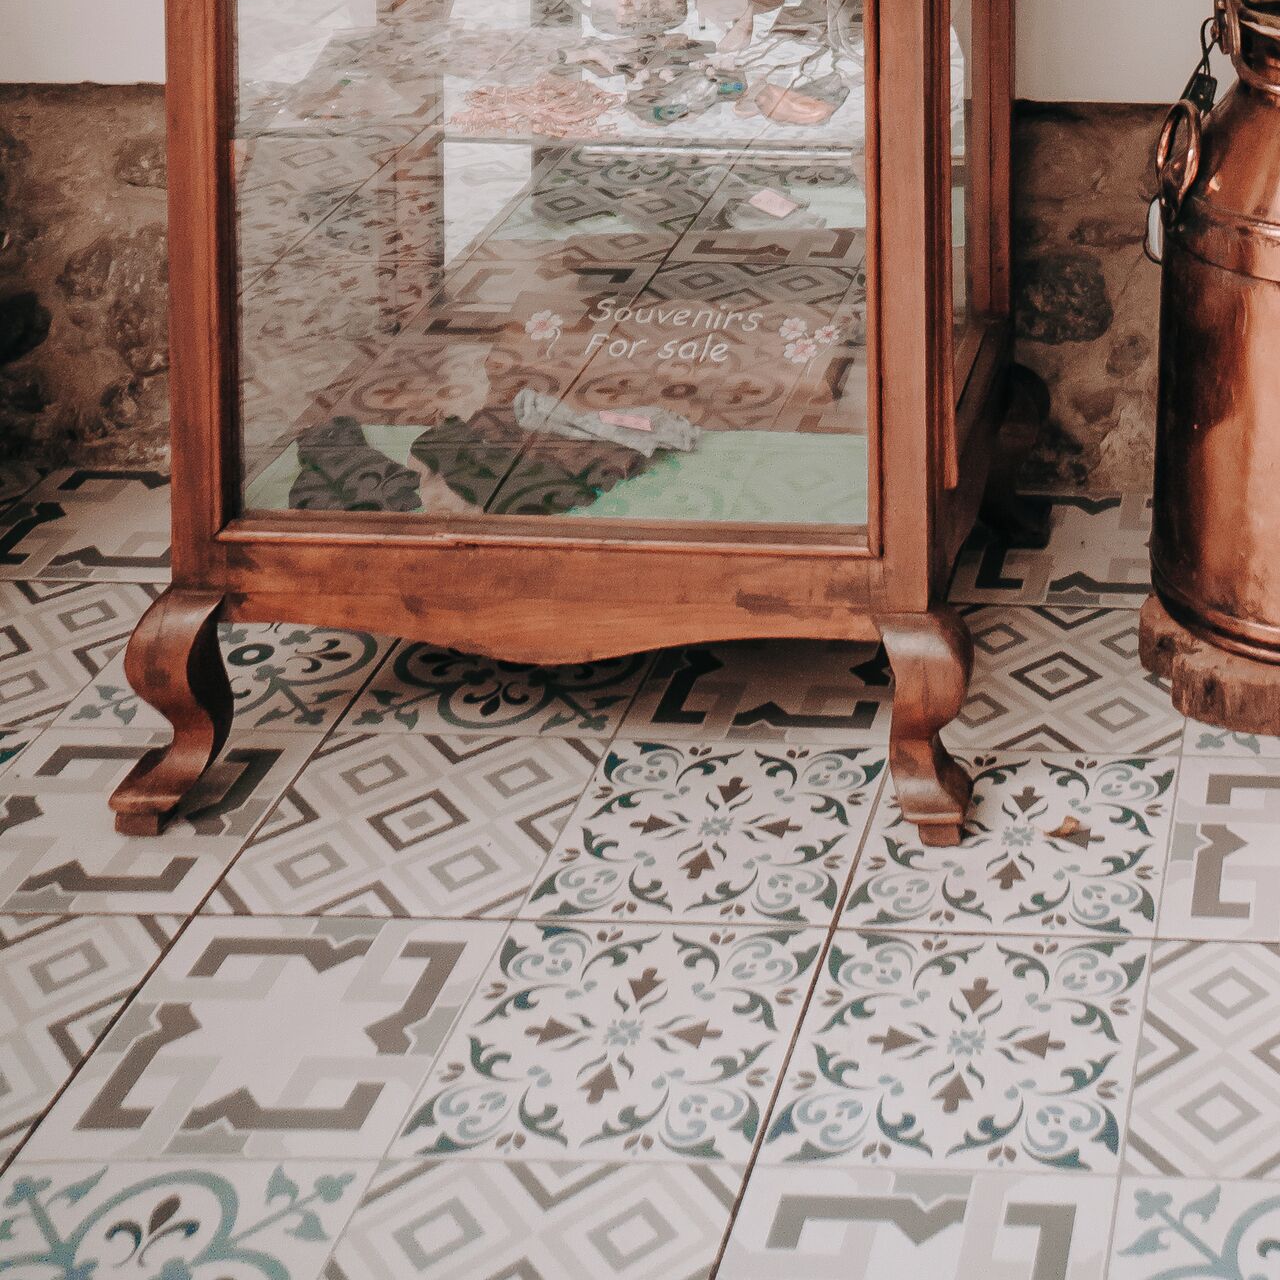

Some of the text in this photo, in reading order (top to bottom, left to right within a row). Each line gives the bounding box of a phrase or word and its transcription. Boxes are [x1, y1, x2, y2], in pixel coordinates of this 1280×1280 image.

[589, 297, 764, 333] Souvenirs
[584, 334, 730, 363] For sale
